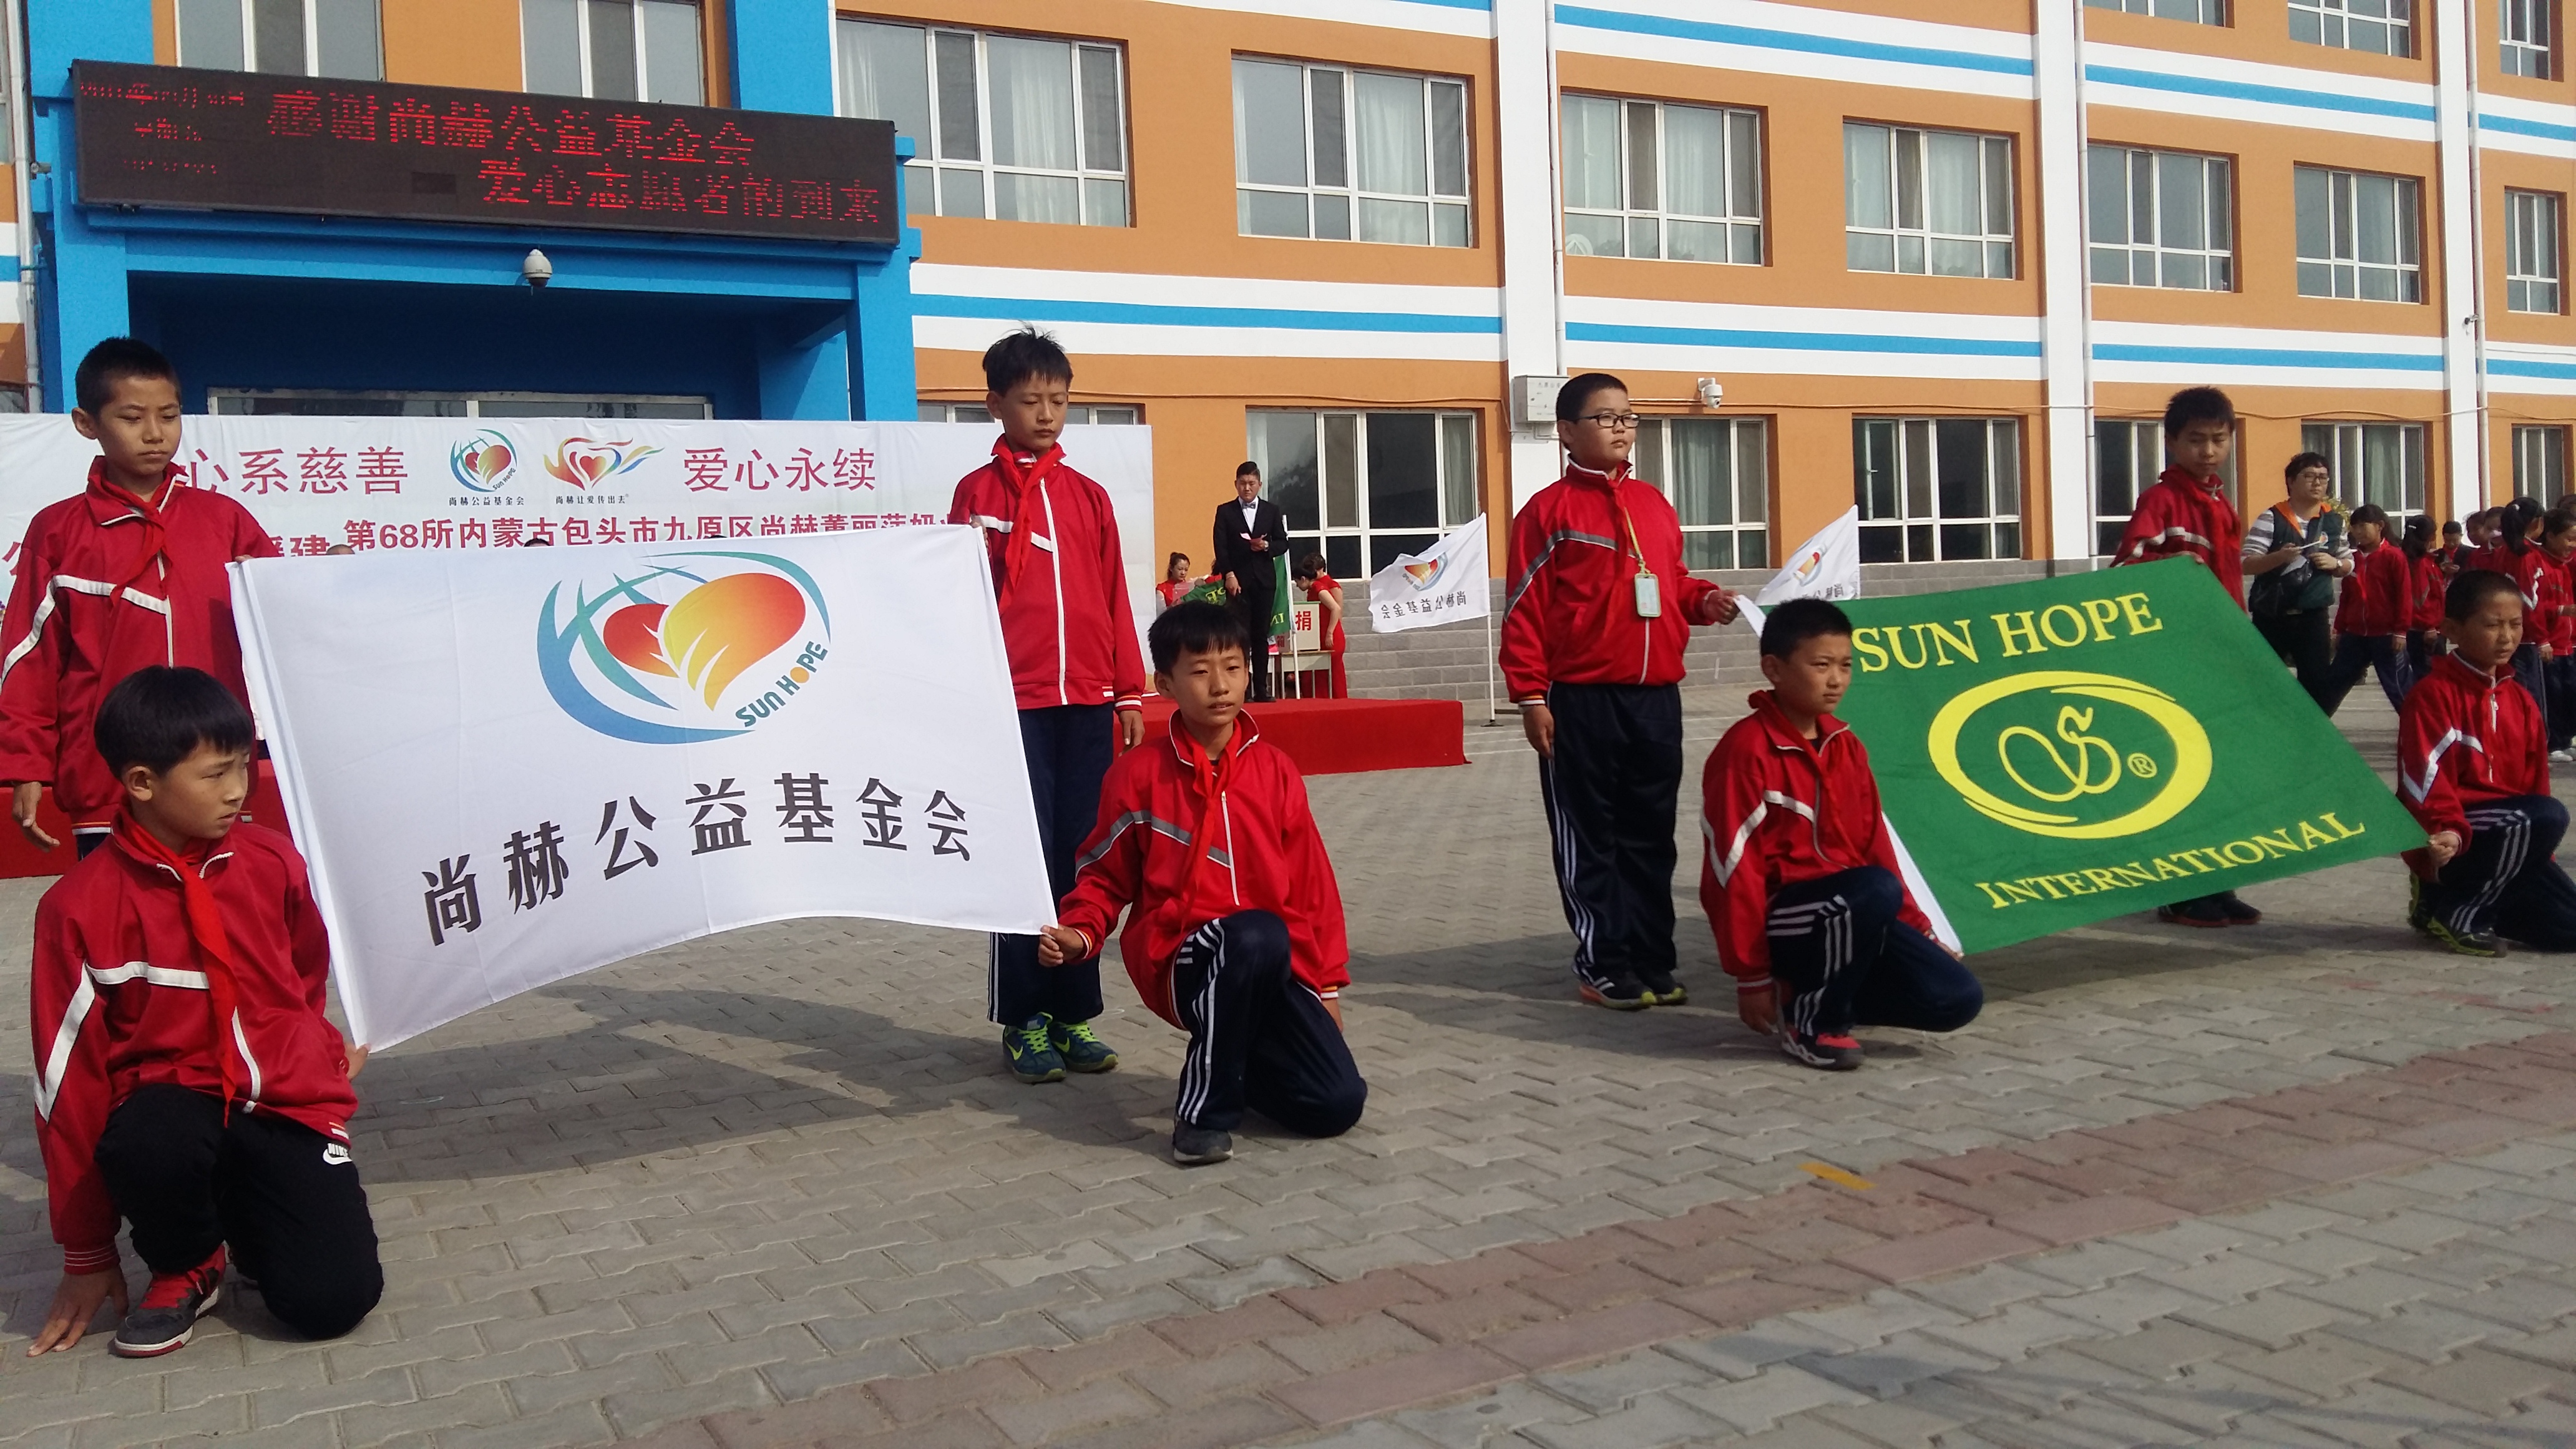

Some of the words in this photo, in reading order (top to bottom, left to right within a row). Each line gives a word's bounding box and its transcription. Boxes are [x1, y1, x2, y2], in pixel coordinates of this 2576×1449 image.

[477, 157, 879, 223] 爱心志愿者的到来
[180, 446, 408, 495] 心系慈善
[684, 447, 876, 492] 爱心永续
[449, 496, 525, 506] 尚赫公益基金会
[555, 495, 626, 504] 尚赫让爱传出去
[1295, 610, 1312, 631] 捐
[1852, 619, 1979, 673] SUN
[1990, 592, 2164, 658] HOPE
[735, 691, 786, 728] SUN
[775, 641, 829, 696] HOPE
[421, 772, 972, 947] 尚赫公益基金会
[1975, 812, 2366, 909] INTERNATIONAL
